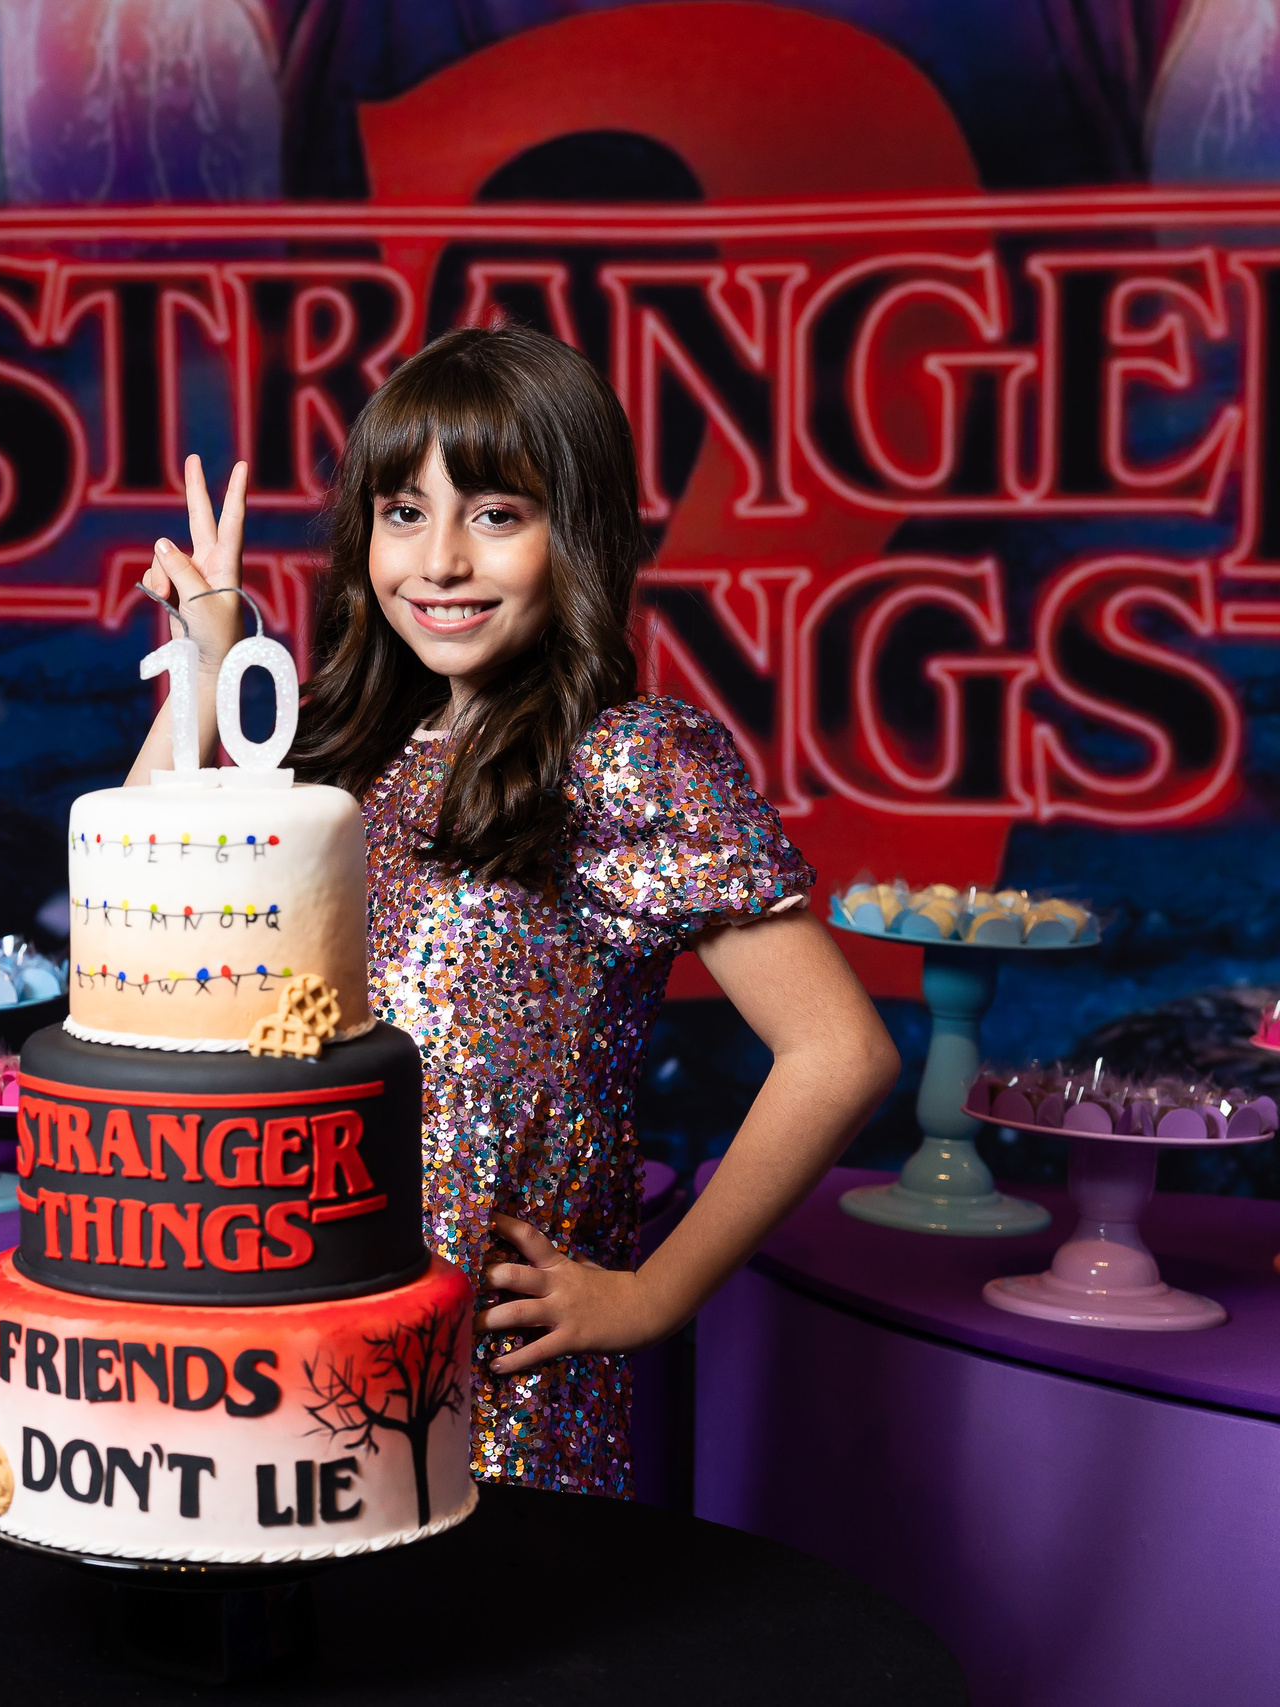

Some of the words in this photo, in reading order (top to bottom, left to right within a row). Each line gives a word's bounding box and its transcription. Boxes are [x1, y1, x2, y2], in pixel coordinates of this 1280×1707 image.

[102, 550, 1244, 828] TNGS
[16, 1095, 375, 1200] STRANGER
[36, 1187, 315, 1272] THINGS
[21, 1426, 217, 1519] DON'T
[255, 1456, 365, 1528] LIE
